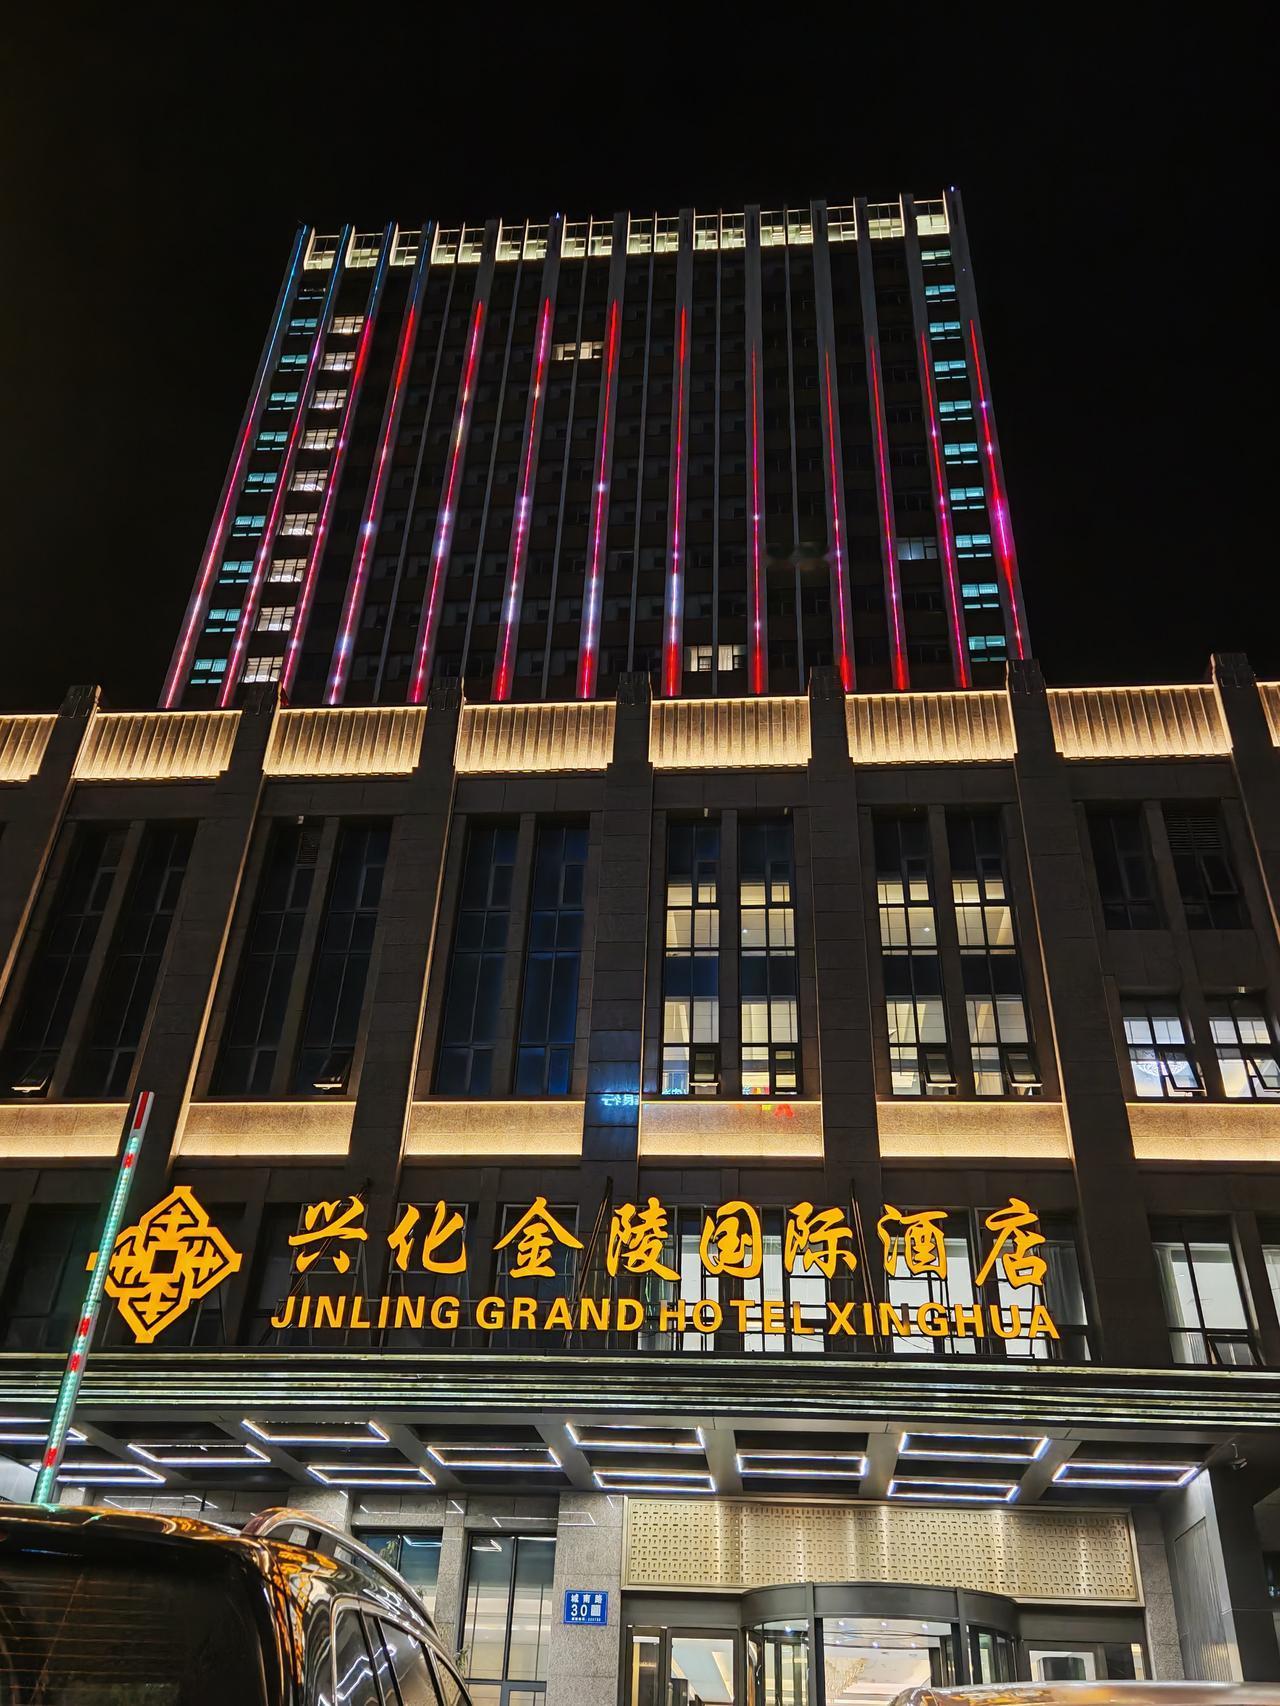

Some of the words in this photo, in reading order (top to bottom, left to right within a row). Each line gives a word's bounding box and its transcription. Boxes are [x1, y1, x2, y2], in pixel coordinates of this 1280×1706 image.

[288, 1196, 1048, 1288] 兴化金陵国际酒店
[270, 1295, 460, 1329] JINLING
[475, 1296, 645, 1331] GRAND
[659, 1299, 815, 1334] HOTEL
[827, 1301, 1060, 1339] XINGHUA
